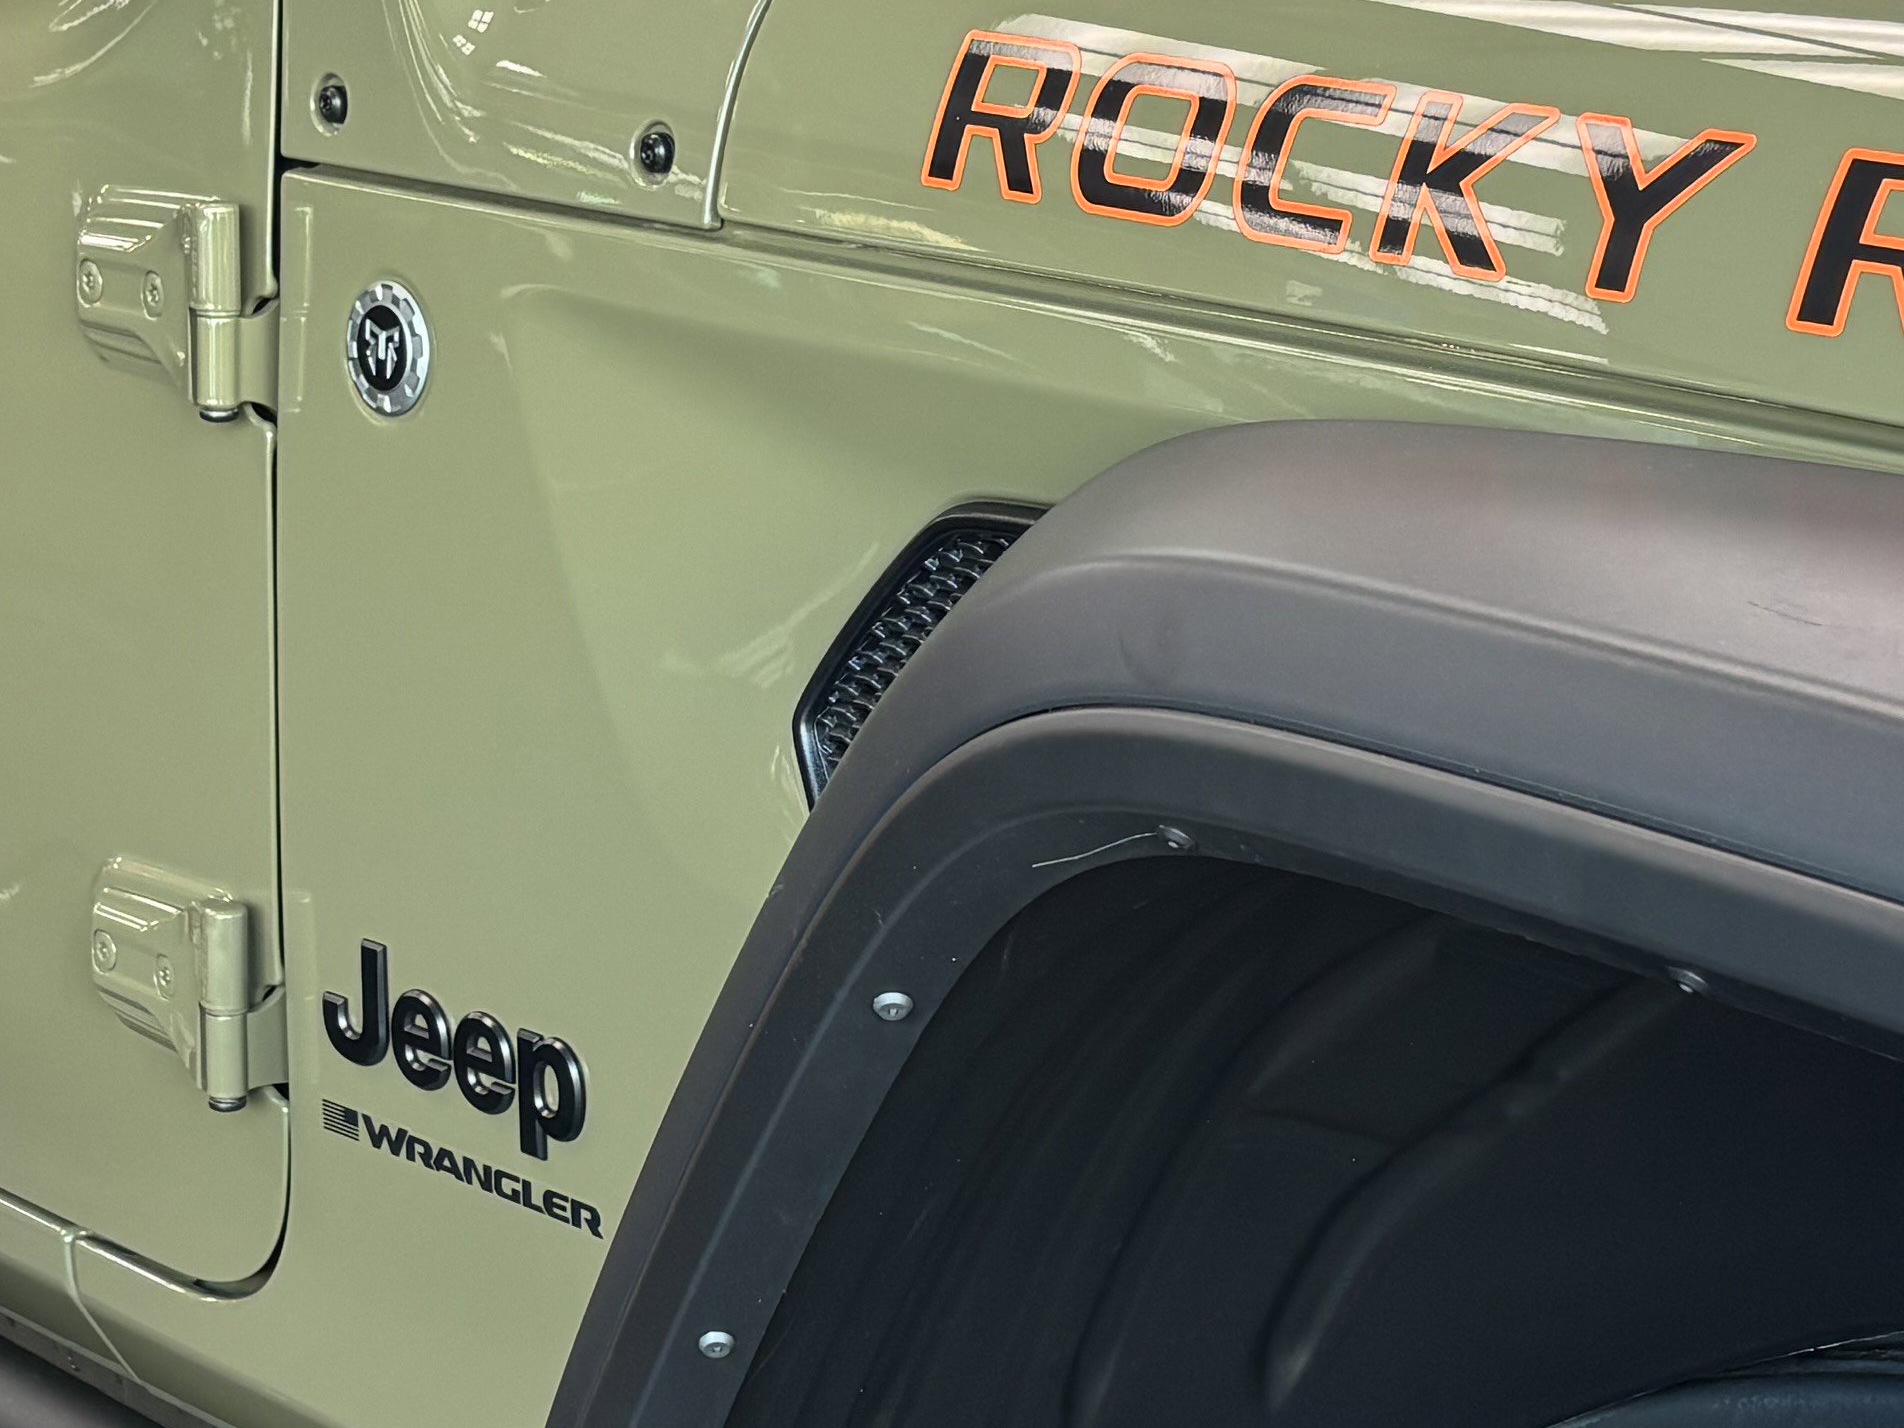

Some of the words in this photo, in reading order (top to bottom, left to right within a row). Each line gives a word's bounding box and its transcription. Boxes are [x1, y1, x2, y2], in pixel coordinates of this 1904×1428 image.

[920, 27, 1757, 302] ROCKY
[322, 938, 587, 1161] Jeep
[361, 1113, 604, 1240] WRANGLER
